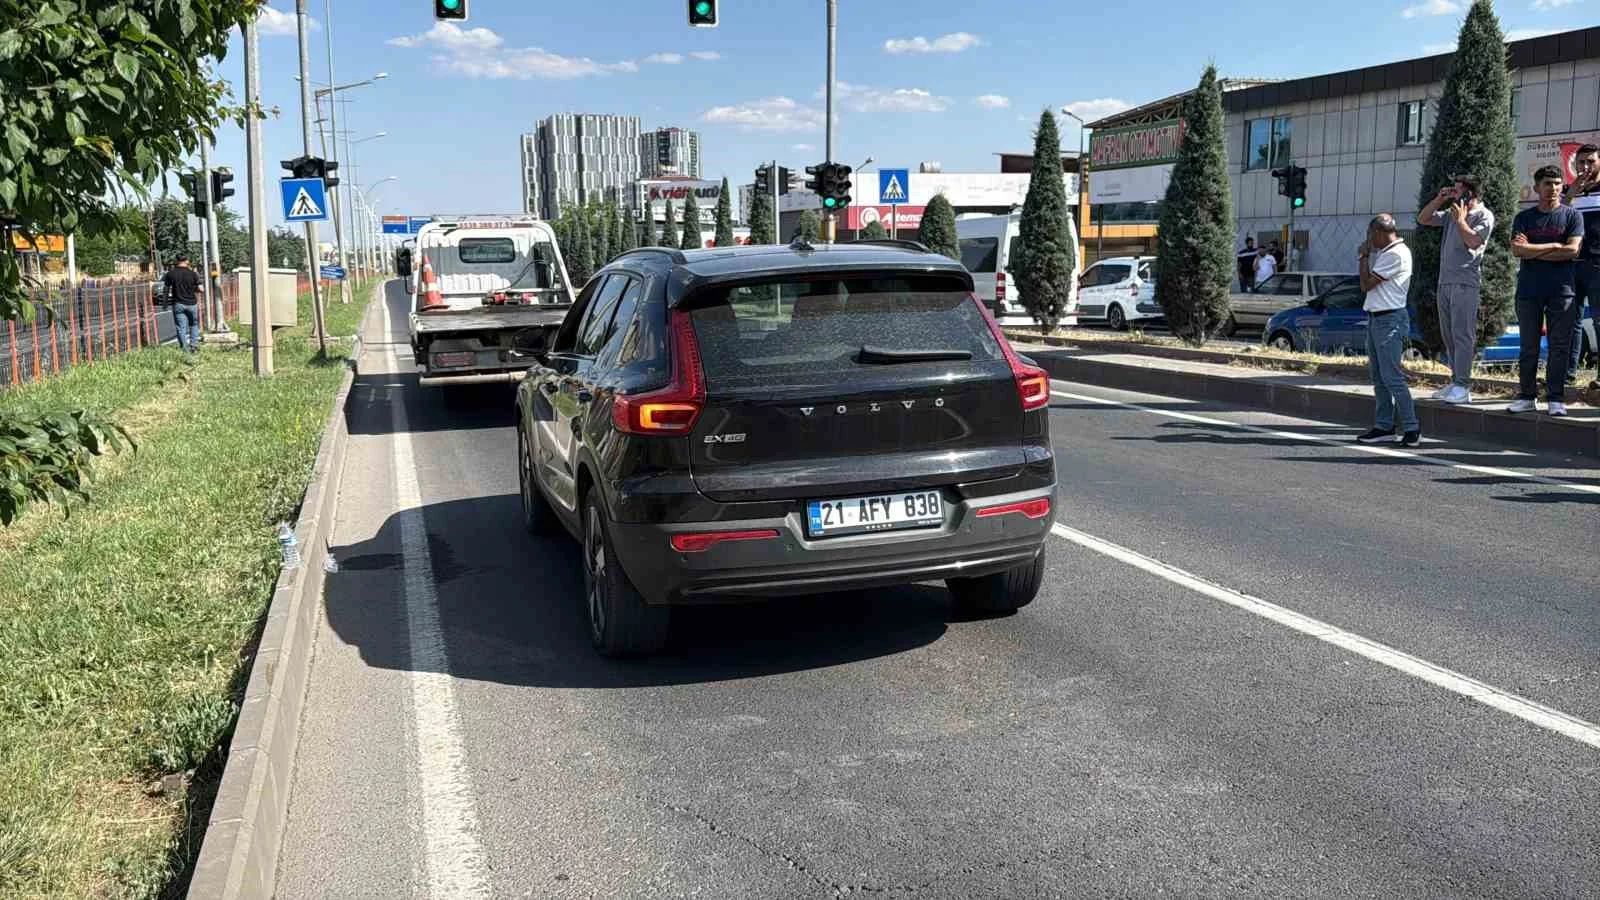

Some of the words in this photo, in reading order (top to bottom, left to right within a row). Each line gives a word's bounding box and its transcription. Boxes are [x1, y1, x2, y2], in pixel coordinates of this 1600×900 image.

[800, 397, 944, 417] VOLVO
[822, 501, 845, 526] 21
[859, 496, 892, 522] AFY
[903, 492, 940, 518] 838
